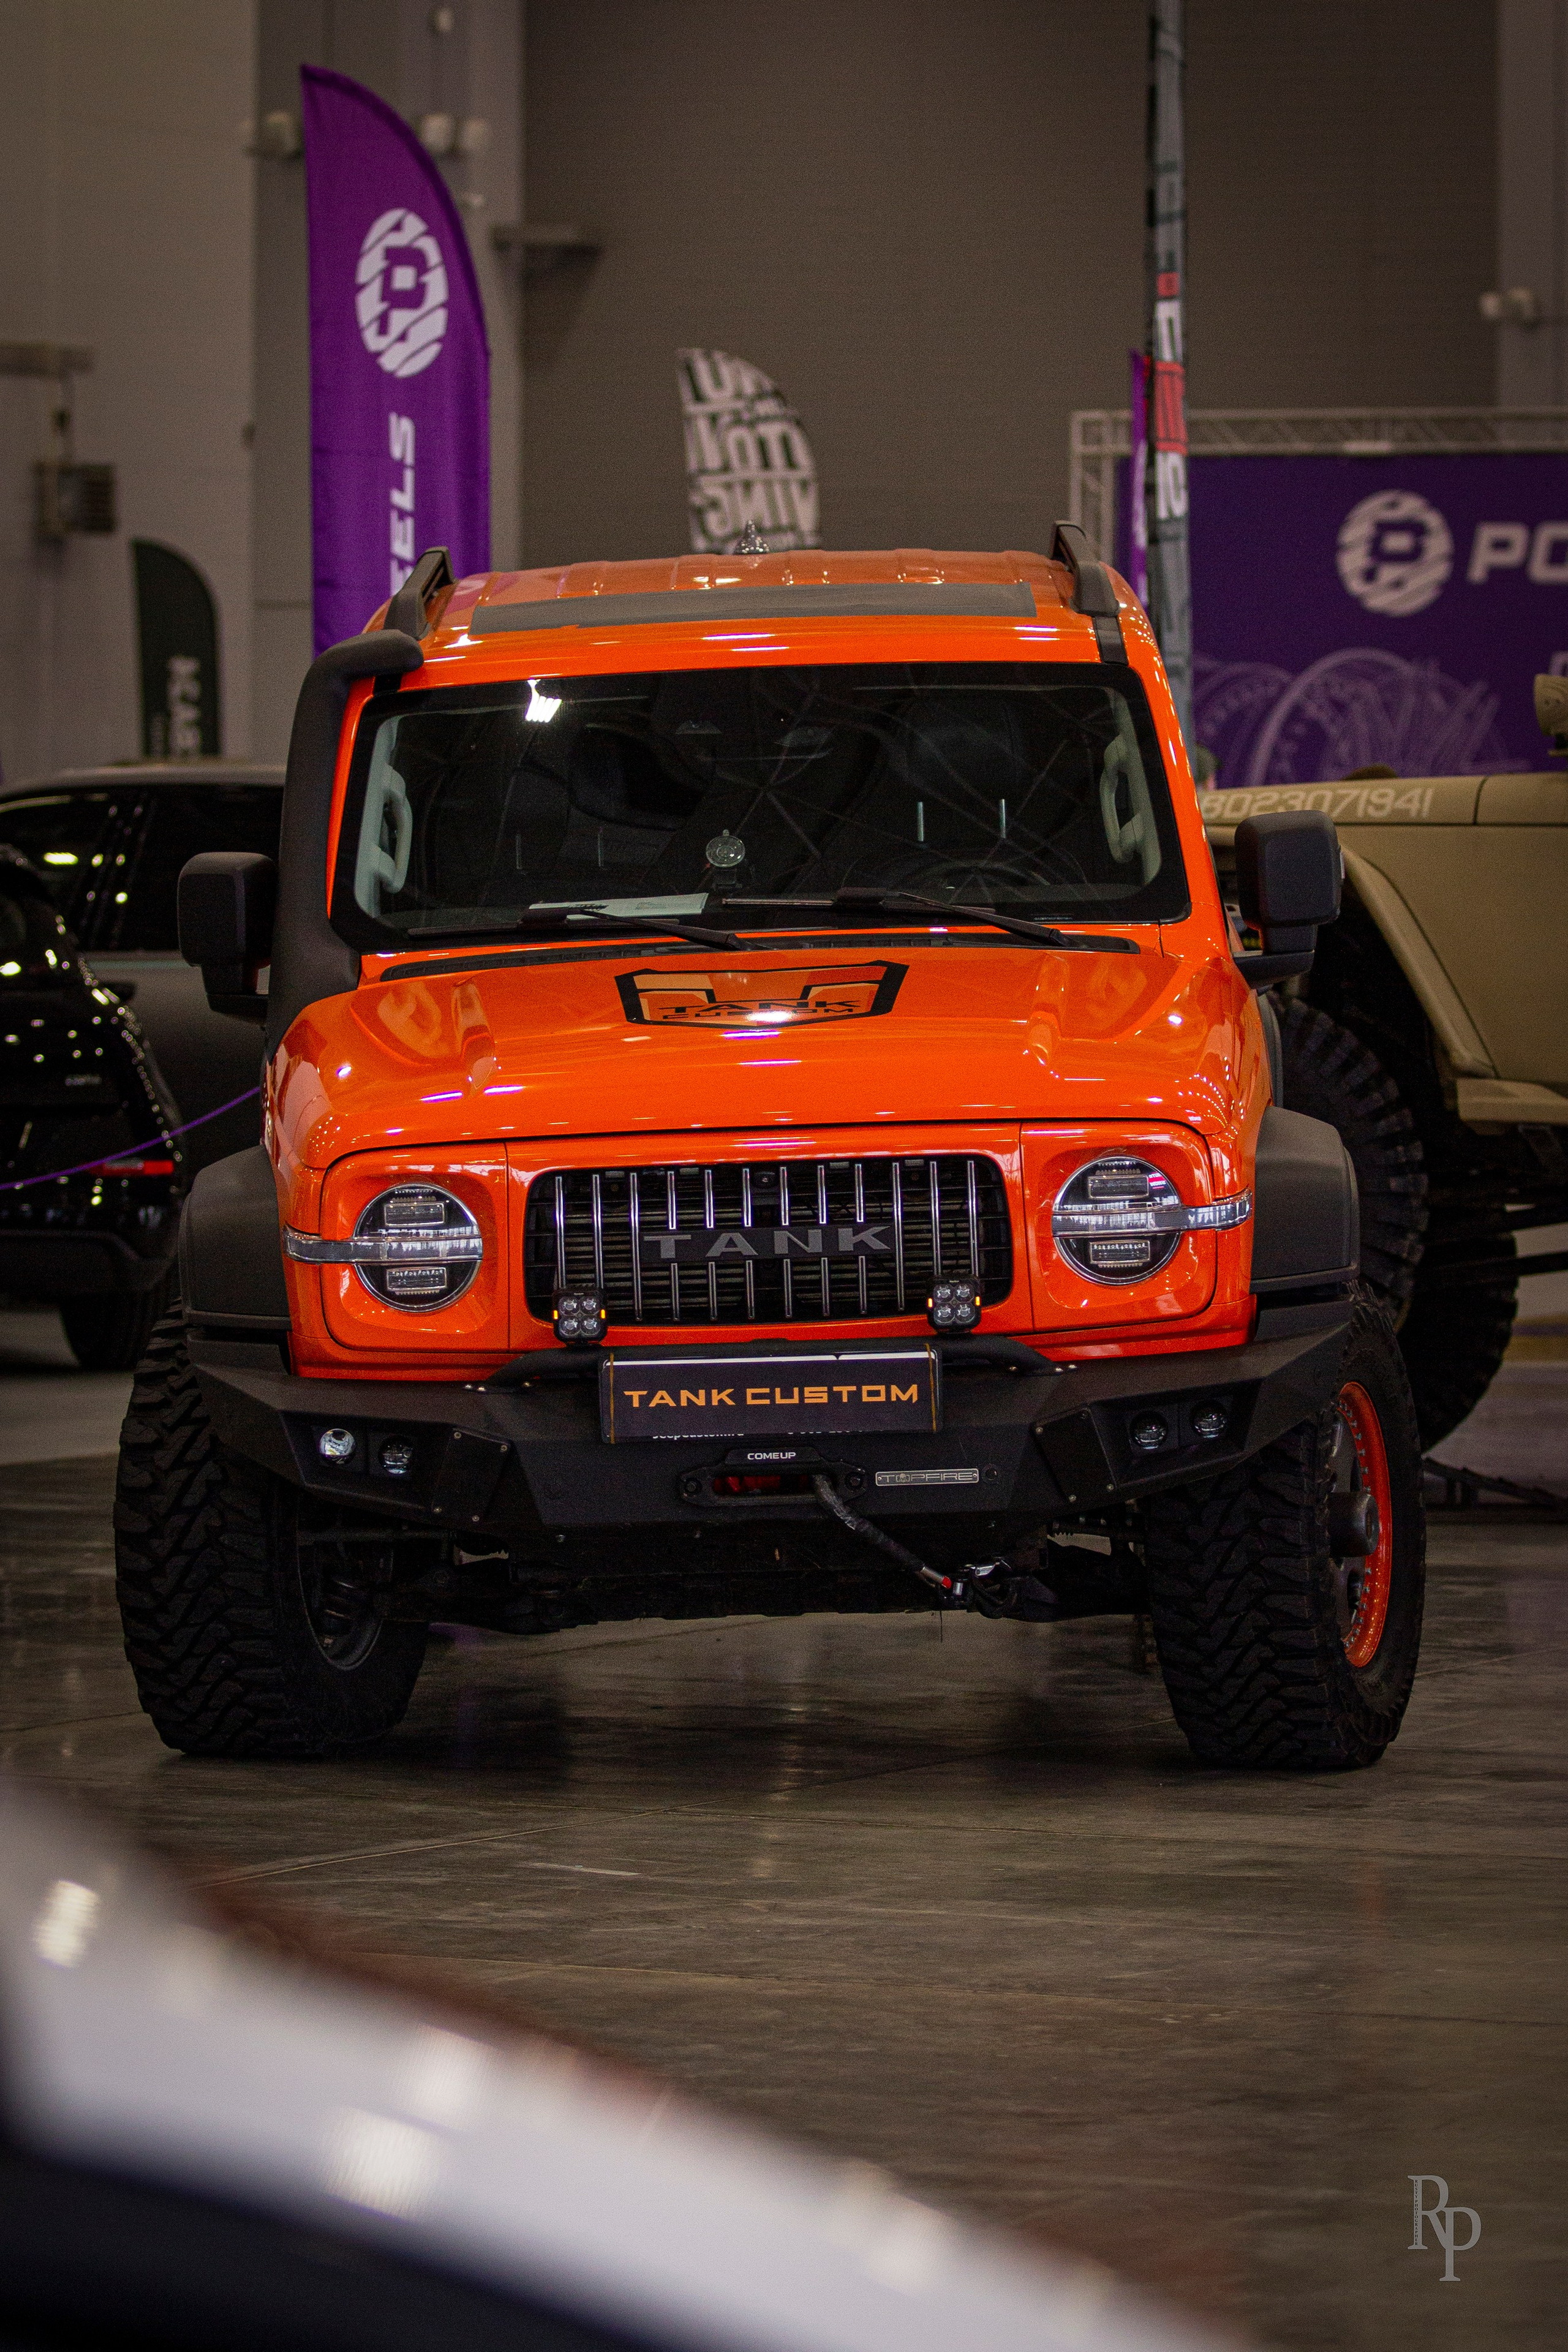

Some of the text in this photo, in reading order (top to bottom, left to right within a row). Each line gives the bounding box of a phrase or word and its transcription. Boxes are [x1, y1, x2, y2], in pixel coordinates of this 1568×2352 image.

[644, 1226, 892, 1259] TANK
[624, 1384, 919, 1408] TANK CUSTOM
[747, 1452, 796, 1460] COMEUP
[881, 1472, 973, 1483] TOPFIRE
